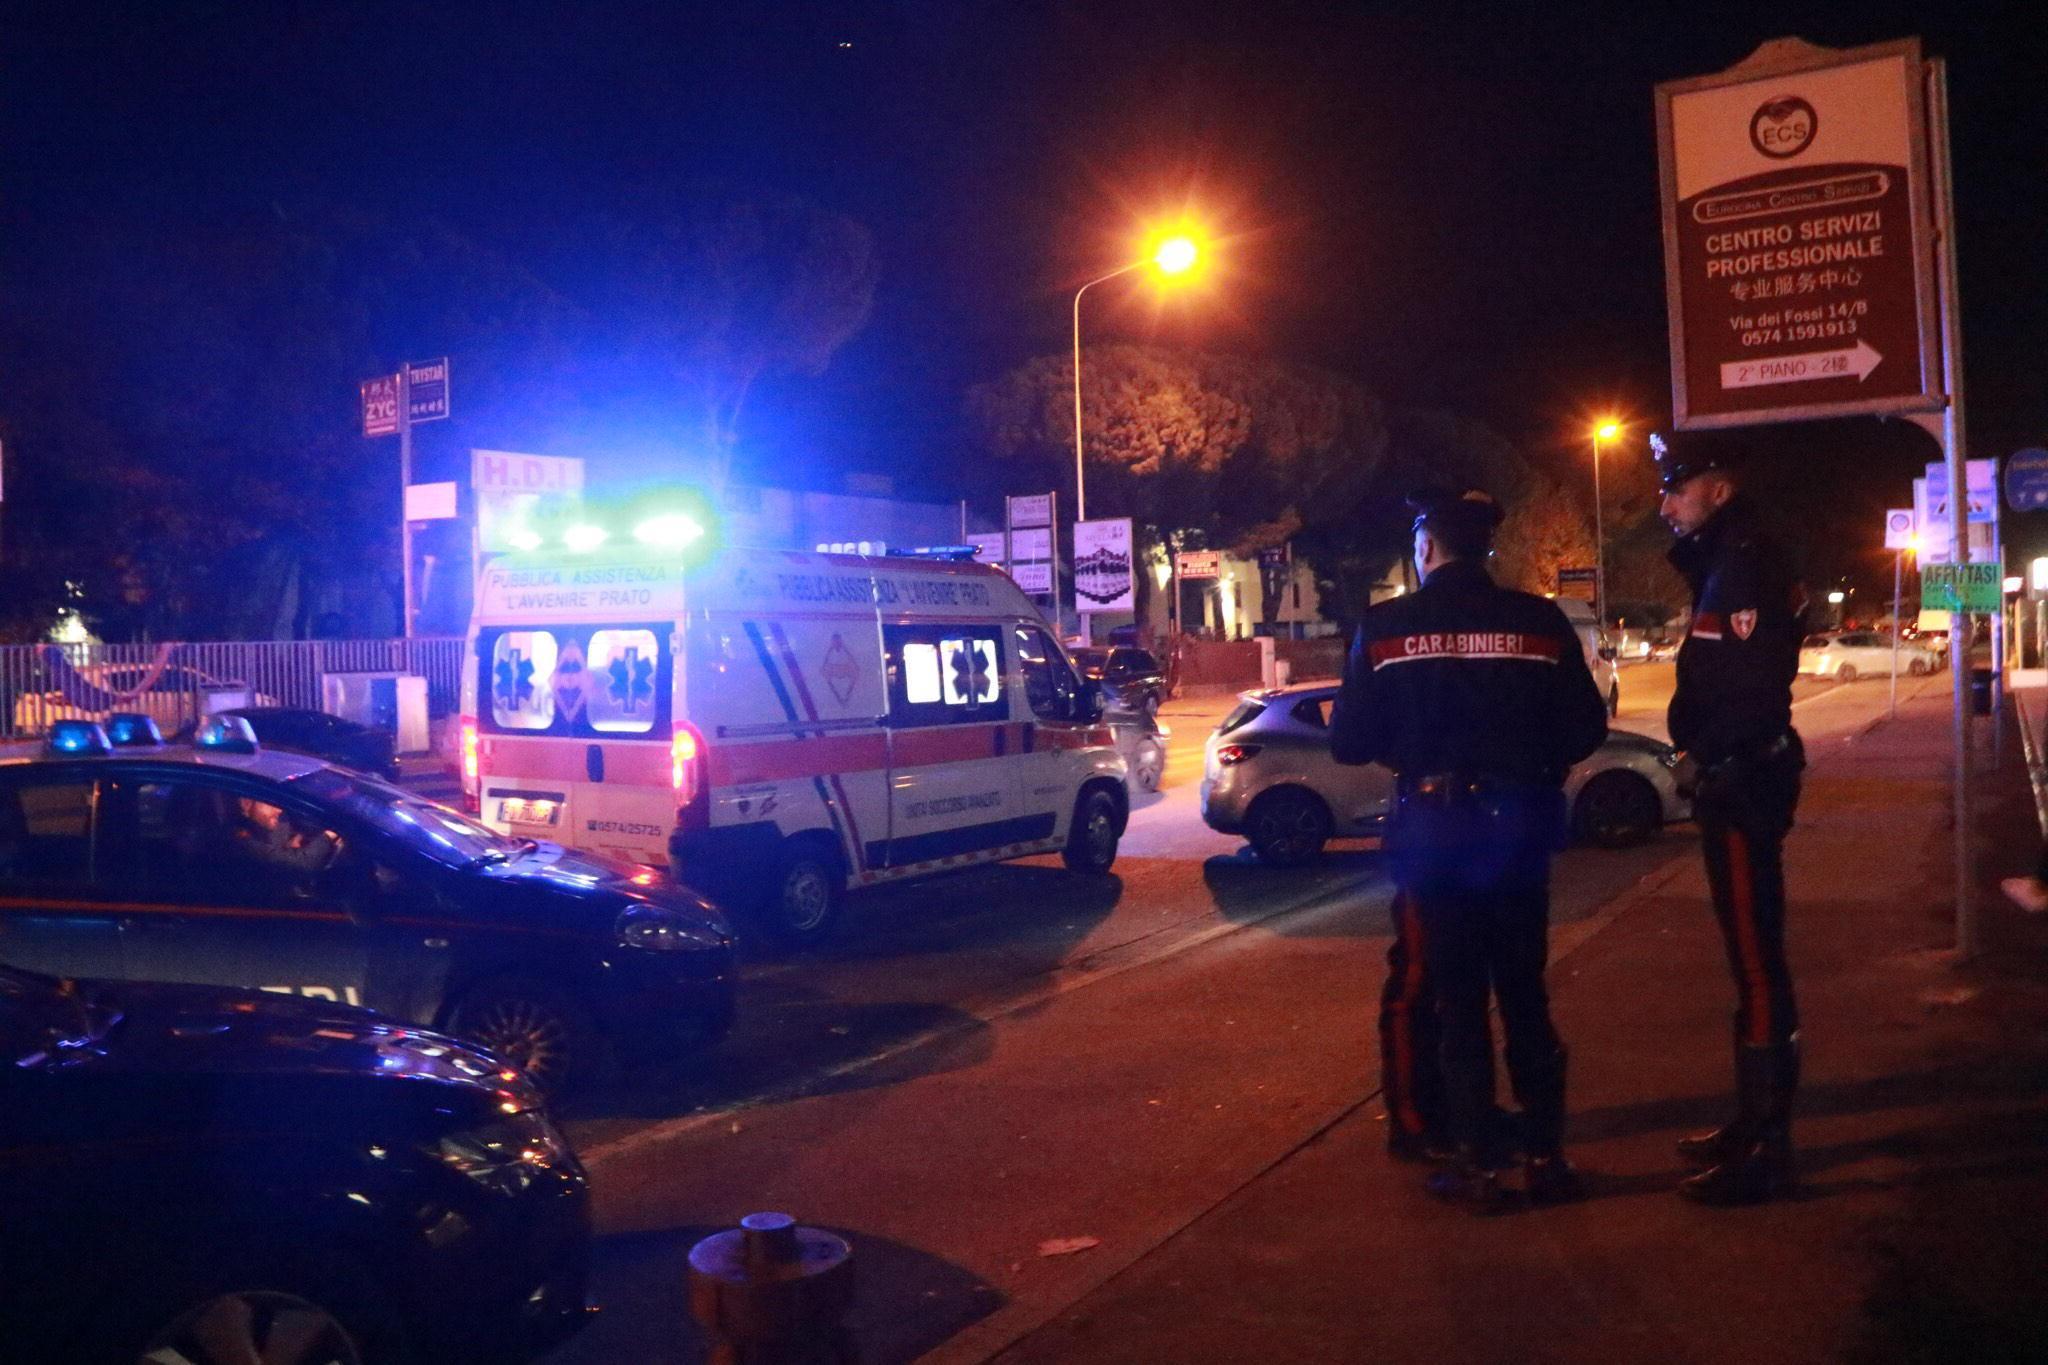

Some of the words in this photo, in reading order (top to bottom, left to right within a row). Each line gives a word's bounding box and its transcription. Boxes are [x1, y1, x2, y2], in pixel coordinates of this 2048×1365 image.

[1763, 120, 1807, 146] ECS
[1705, 225, 1792, 254] CENTRO
[1800, 210, 1881, 241] SERVIZI
[1706, 236, 1884, 278] PROFESSIONALE
[1730, 267, 1861, 300] 专业服务中心
[1730, 314, 1753, 330] Via
[1742, 328, 1781, 346] 0574
[1787, 318, 1857, 341] 1591913
[1760, 359, 1807, 379] PIANO
[366, 400, 397, 420] ZYC
[491, 571, 562, 588] PUBBLICA
[573, 566, 667, 585] ASSISTENZA
[599, 588, 651, 606] PRATO
[1404, 633, 1524, 655] CARABINIERI
